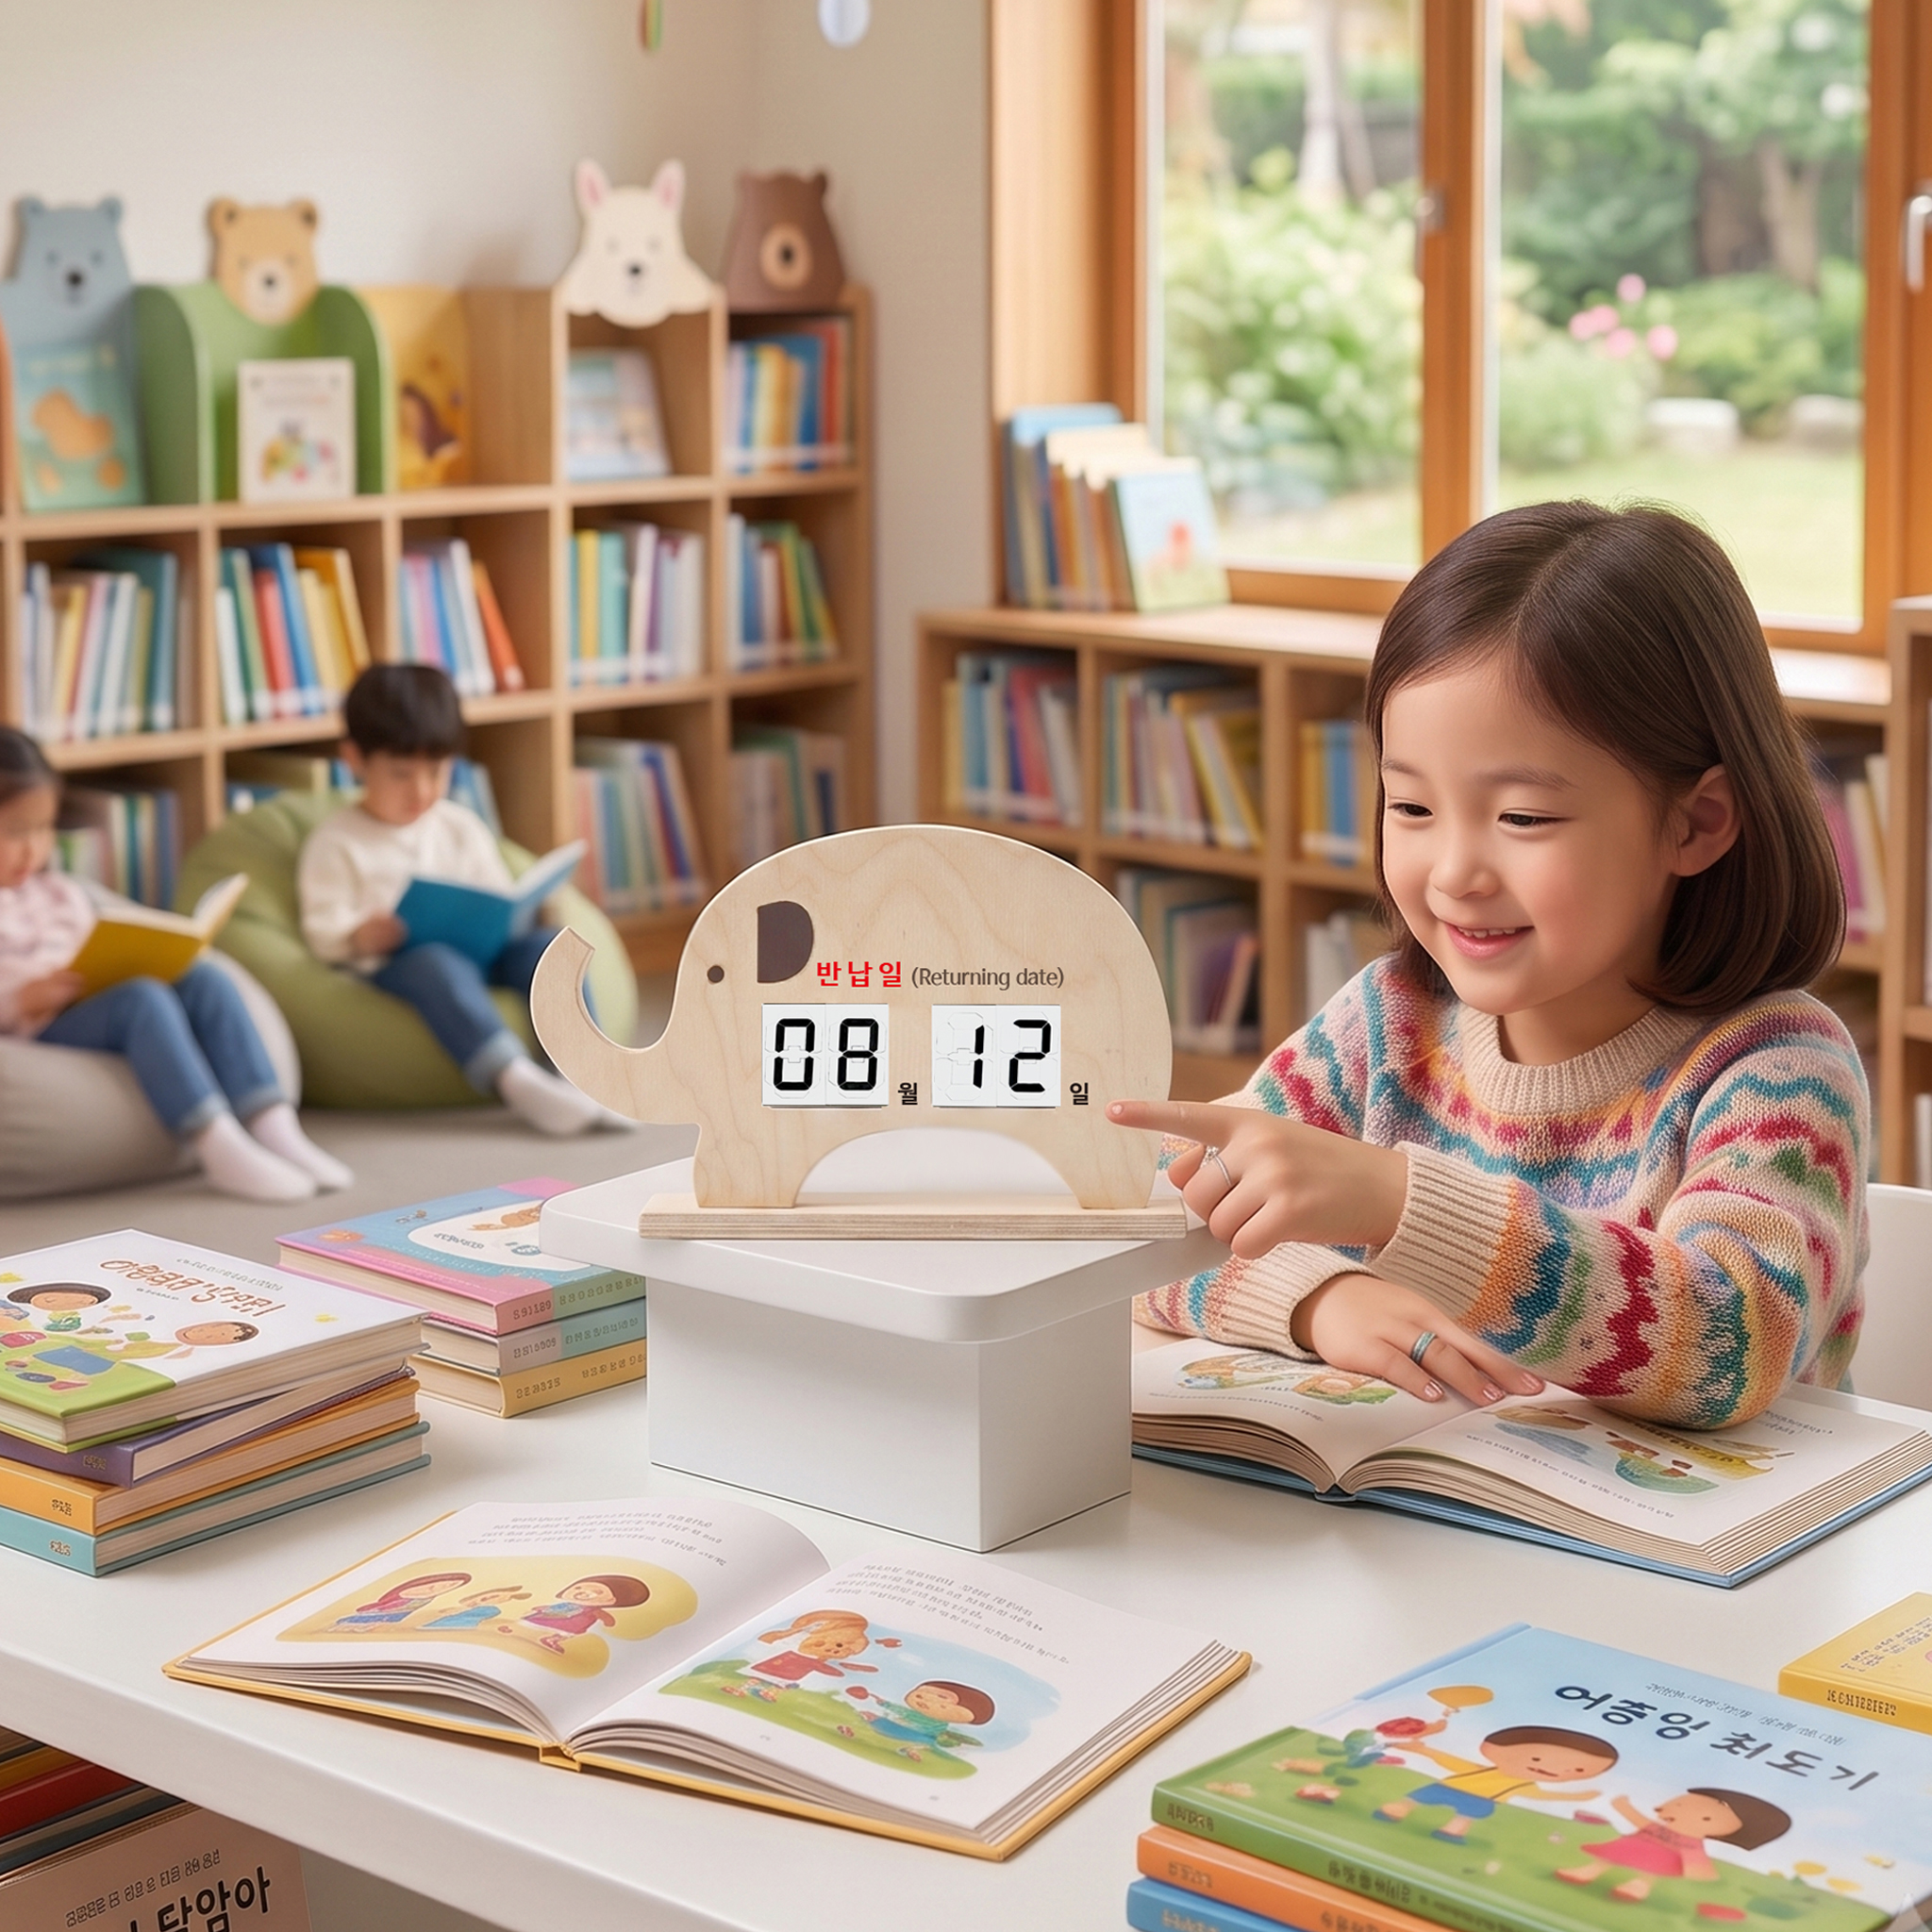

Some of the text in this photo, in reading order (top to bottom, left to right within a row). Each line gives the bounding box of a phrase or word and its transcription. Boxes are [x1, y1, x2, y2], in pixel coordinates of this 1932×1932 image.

[910, 966, 1010, 991] (Returning
[1015, 966, 1065, 990] date)
[897, 1082, 918, 1106] 월
[1070, 1082, 1089, 1106] 일
